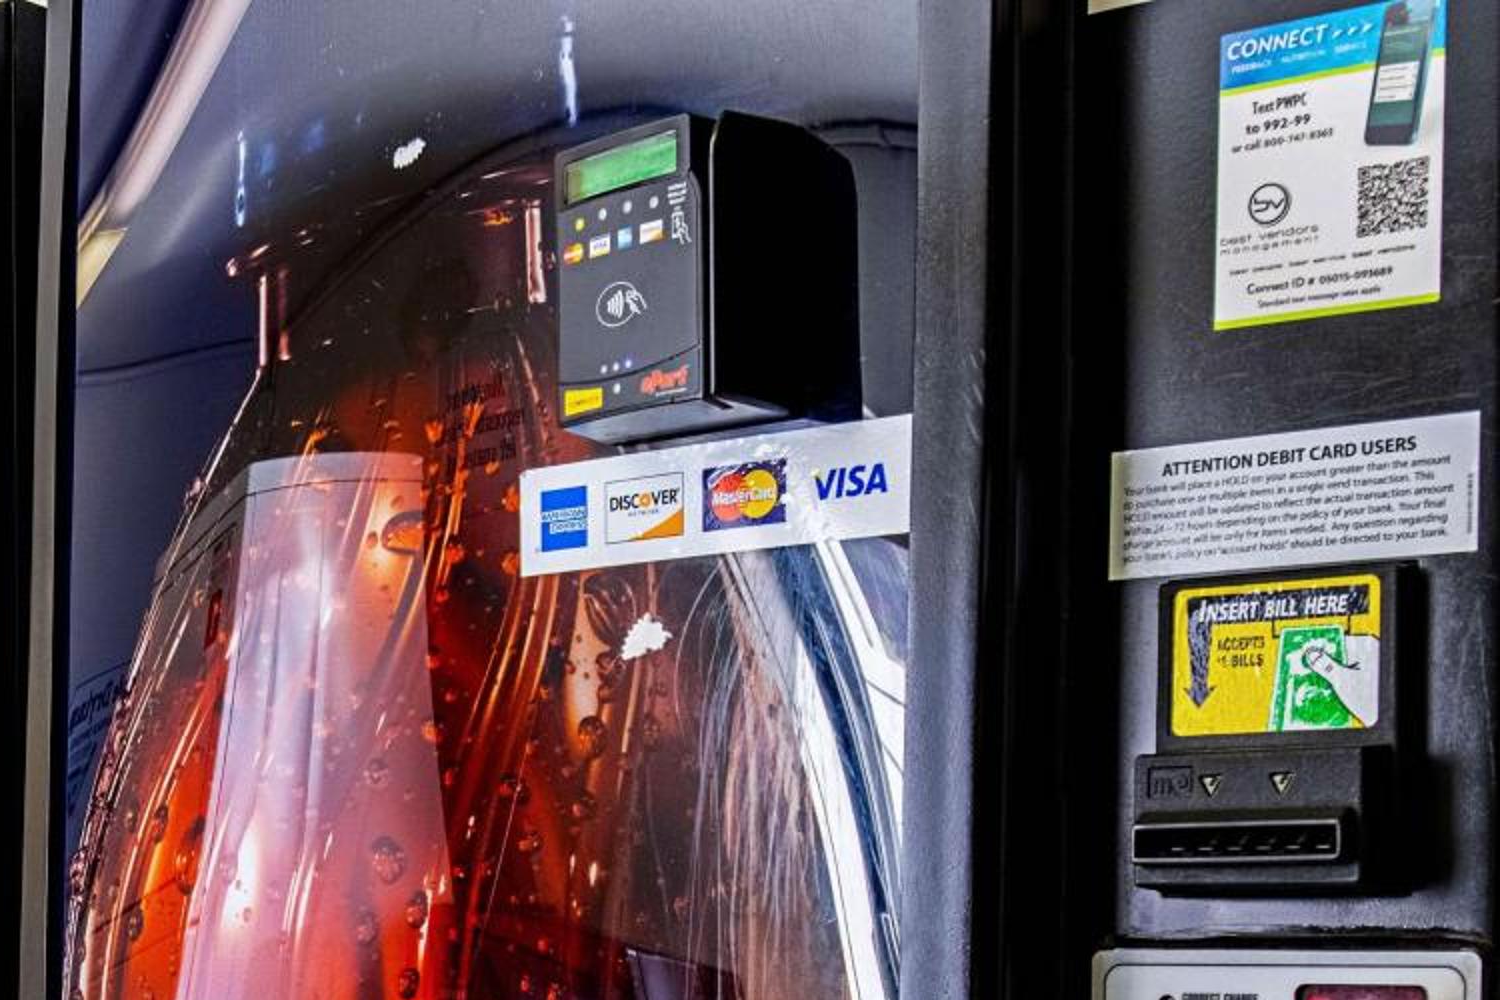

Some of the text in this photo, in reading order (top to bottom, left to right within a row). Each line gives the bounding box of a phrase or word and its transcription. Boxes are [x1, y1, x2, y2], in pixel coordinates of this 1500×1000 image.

[1227, 25, 1327, 59] CONNECT
[1252, 99, 1275, 114] Text
[1246, 113, 1310, 133] to 992-99
[1243, 139, 1260, 150] call
[1258, 224, 1318, 240] vendors
[1247, 279, 1288, 294] Connect
[1291, 276, 1305, 288] ID
[1162, 435, 1417, 476] ATTENTION DEBIT CARD USERS
[1289, 467, 1326, 479] account
[1329, 463, 1364, 477] greater
[1366, 461, 1389, 471] than
[1391, 459, 1408, 468] the
[1410, 454, 1450, 466] amount
[814, 462, 888, 500] VISA
[610, 489, 678, 512] DISCOVER
[712, 486, 776, 506] MasterCard
[1273, 497, 1303, 507] reflect
[1305, 495, 1321, 504] the
[1323, 492, 1352, 503] actual
[1355, 486, 1411, 500] transaction
[1413, 482, 1454, 494] amount
[1282, 511, 1298, 520] the
[1299, 508, 1331, 521] policy
[1333, 507, 1343, 516] of
[1345, 508, 1364, 517] your
[1330, 520, 1350, 532] Any
[1352, 516, 1396, 531] question
[1398, 512, 1448, 527] regarding
[1290, 531, 1419, 547] should be directed to your
[1199, 595, 1350, 622] INSERT BILL HERE
[1232, 654, 1264, 667] BILLS
